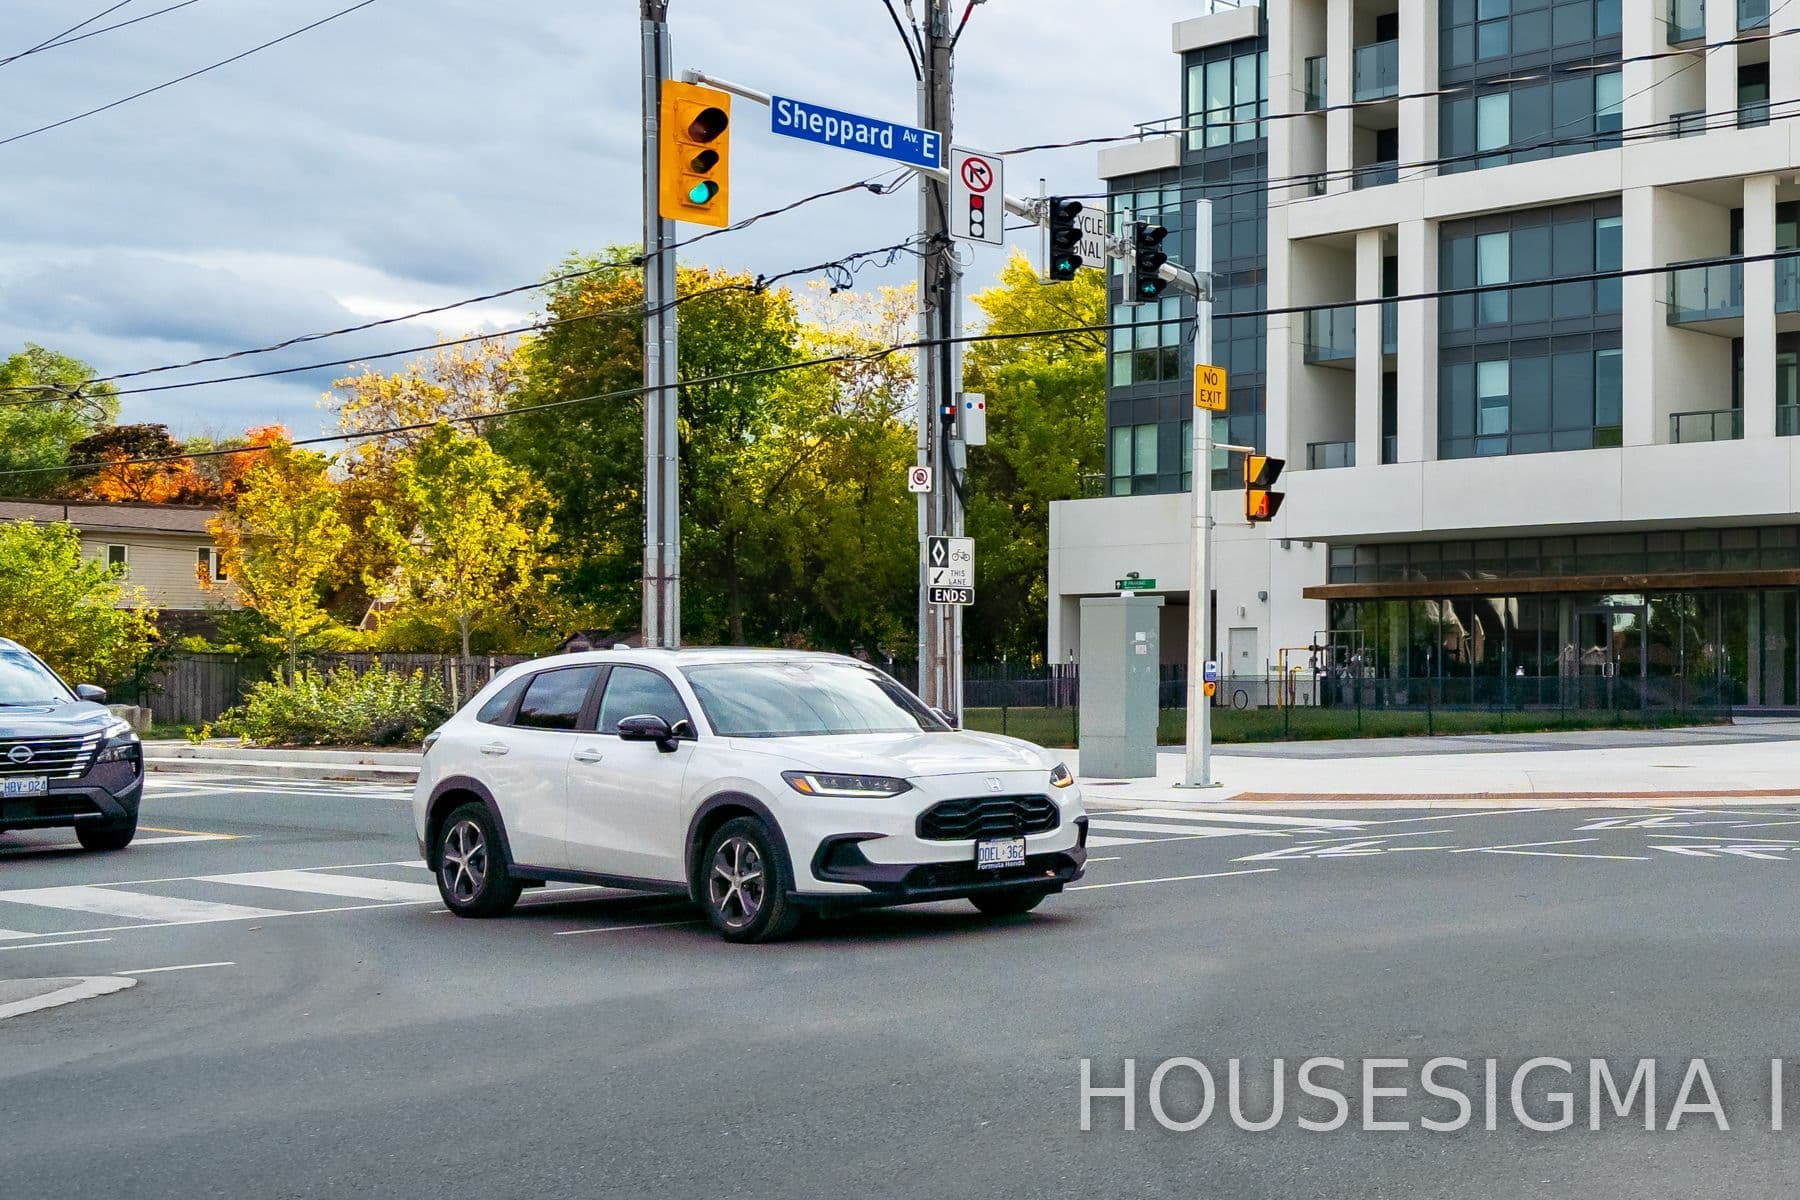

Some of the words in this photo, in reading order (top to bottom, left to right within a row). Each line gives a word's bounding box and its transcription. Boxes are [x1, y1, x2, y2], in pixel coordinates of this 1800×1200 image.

[777, 99, 893, 150] Sheppard
[922, 133, 935, 159] E
[1203, 371, 1218, 386] NO
[1200, 389, 1222, 404] EXIT
[951, 569, 966, 577] THIS
[948, 578, 967, 586] LANE
[935, 589, 968, 602] ENDS
